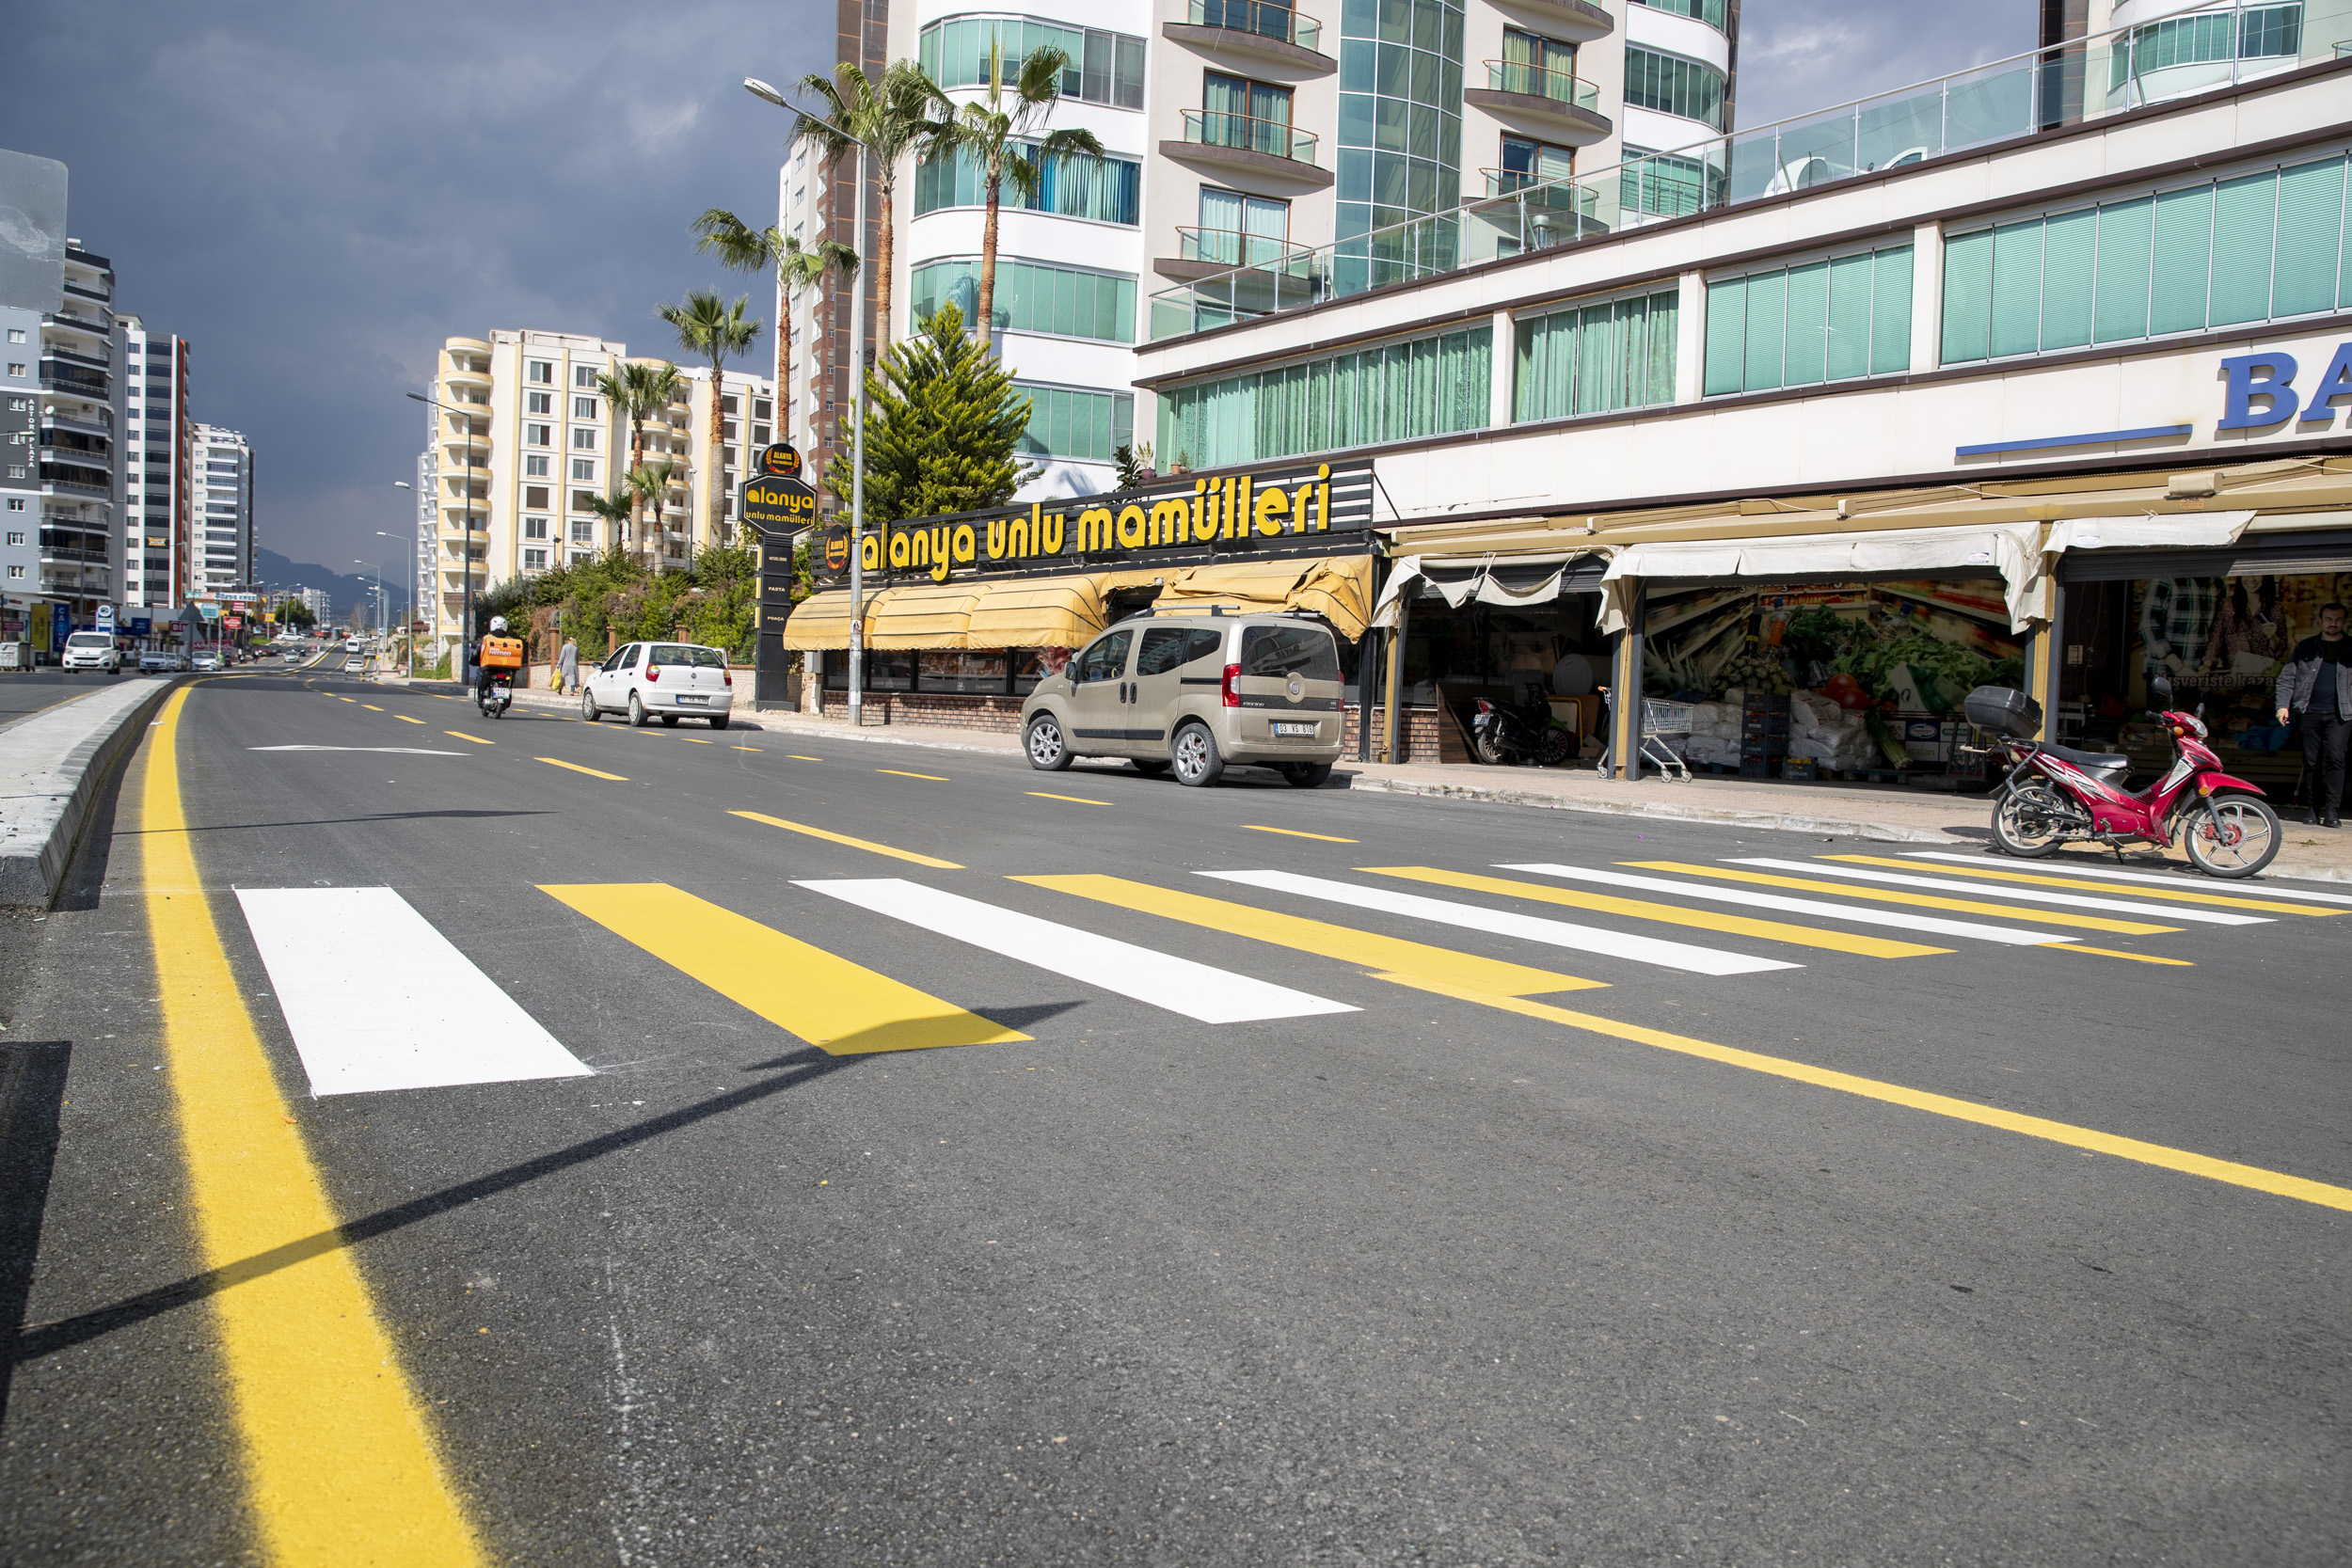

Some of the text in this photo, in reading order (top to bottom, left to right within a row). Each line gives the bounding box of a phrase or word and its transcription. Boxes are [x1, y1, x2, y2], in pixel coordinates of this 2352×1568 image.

[773, 451, 792, 460] ALANYA
[747, 486, 814, 514] alanya
[745, 511, 813, 524] unlu mamülleri
[862, 464, 1331, 581] alanya unlu mamülleri
[1292, 724, 1299, 733] VS
